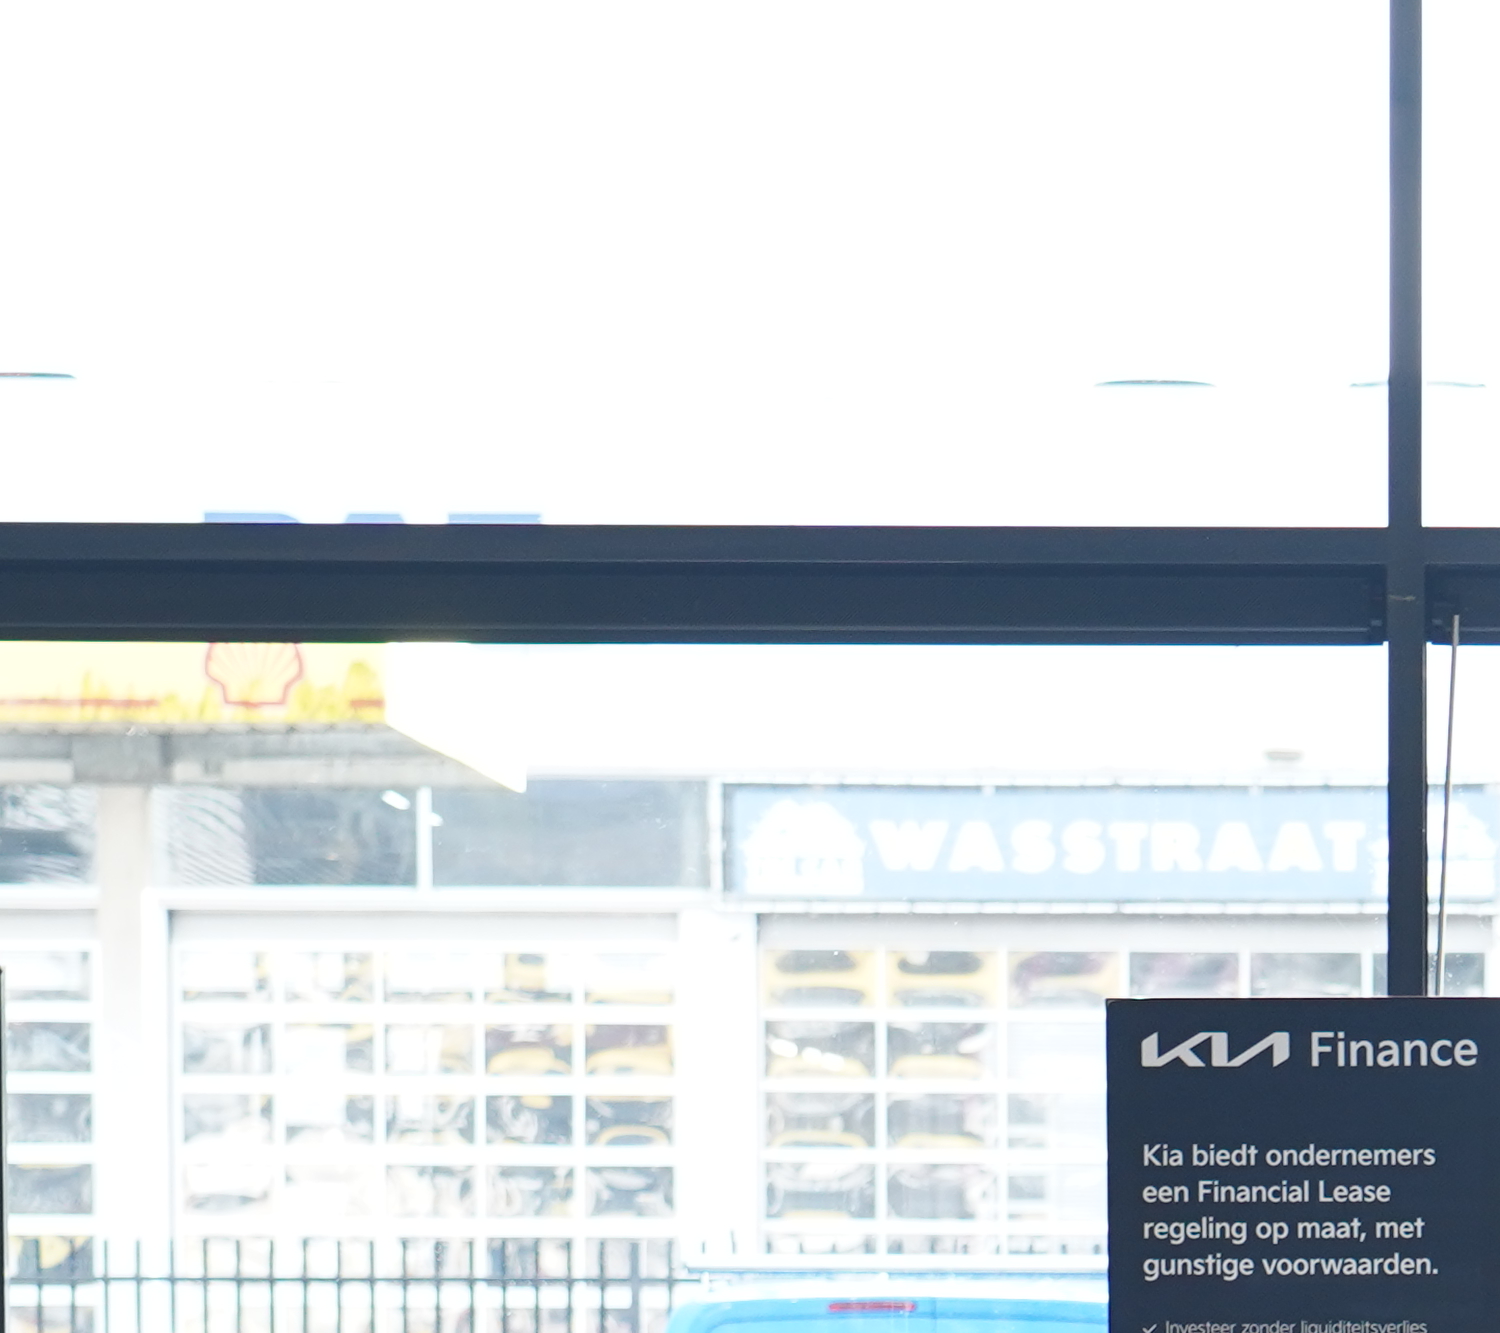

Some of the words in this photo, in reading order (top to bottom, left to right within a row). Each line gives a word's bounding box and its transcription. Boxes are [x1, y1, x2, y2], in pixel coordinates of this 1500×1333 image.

[870, 820, 1366, 874] WASSTRAAT
[1141, 1032, 1290, 1067] KIA
[1312, 1032, 1478, 1067] Finance
[1144, 1144, 1183, 1166] Kia
[1193, 1144, 1258, 1166] biedt
[1266, 1144, 1435, 1166] ondernemers
[1143, 1186, 1188, 1202] een
[1199, 1180, 1309, 1202] Financial
[1319, 1180, 1391, 1202] Lease
[1144, 1217, 1247, 1244] regeling
[1256, 1222, 1288, 1244] op
[1298, 1218, 1366, 1242] maat,
[1376, 1218, 1425, 1238] met
[1144, 1253, 1254, 1281] gunstige
[1262, 1253, 1438, 1275] voorwaarden.
